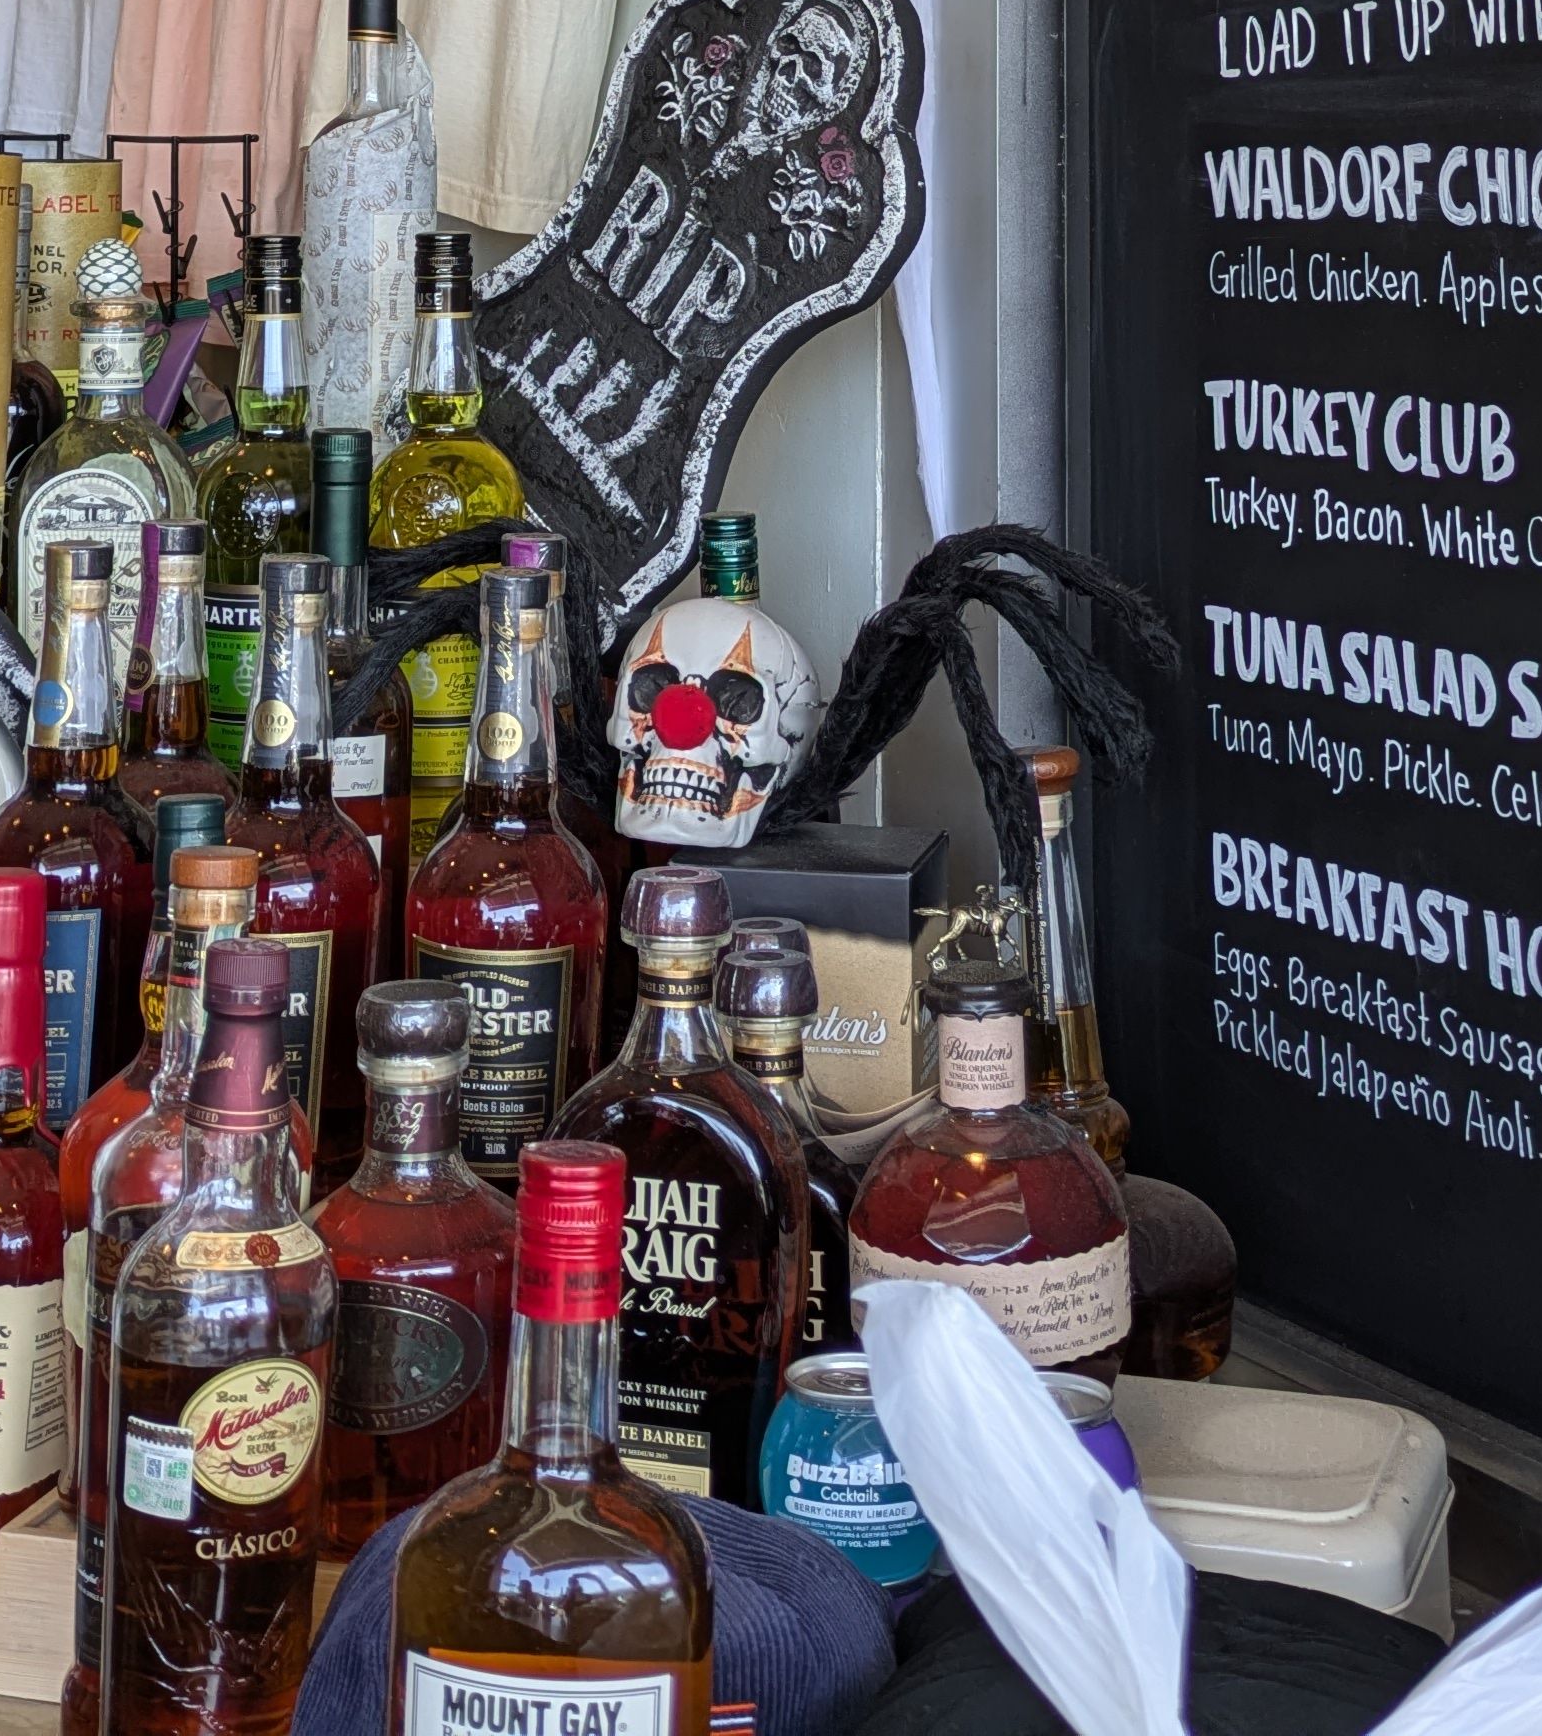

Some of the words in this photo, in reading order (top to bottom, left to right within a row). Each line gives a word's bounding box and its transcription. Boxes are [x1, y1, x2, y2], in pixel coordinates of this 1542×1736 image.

[1218, 6, 1315, 78] LOAD
[1343, 1, 1377, 64] IT
[1205, 142, 1431, 224] WALDORF
[581, 164, 759, 360] RIP
[1209, 246, 1295, 303] Grilled
[1309, 252, 1428, 307] Chicken.
[1204, 379, 1375, 471] TURKEY
[1384, 394, 1514, 483] CLUB
[1206, 476, 1303, 548] Turkey.
[1314, 490, 1413, 547] Bacon.
[1421, 502, 1520, 569] White
[1204, 604, 1333, 696] TUNA
[1342, 629, 1496, 728] SALAD
[1208, 703, 1280, 766] Tuna.
[1288, 717, 1375, 796] Mayo.
[1385, 739, 1481, 810] Pickle.
[1212, 831, 1470, 971] BREAKFAST
[1288, 956, 1433, 1049] Breakfast
[484, 1069, 548, 1081] BARREL
[944, 1036, 1013, 1062] Blanton's
[1215, 999, 1314, 1080] Pickled
[1317, 1039, 1450, 1128] Jalapeño
[640, 1287, 716, 1320] Barrel
[196, 1381, 309, 1453] Matusalem
[645, 1383, 707, 1401] STRAIGHT
[645, 1398, 700, 1415] WHISKEY
[247, 1444, 276, 1455] RUM
[643, 1427, 706, 1449] BARREL
[794, 1501, 821, 1514] BERRY
[825, 1508, 863, 1519] CHERRY
[867, 1507, 907, 1519] LIMEADE
[821, 1486, 879, 1503] Cocktails
[196, 1527, 298, 1560] CLÁSICO
[443, 1684, 551, 1736] MOUNT
[560, 1701, 622, 1736] GAY
